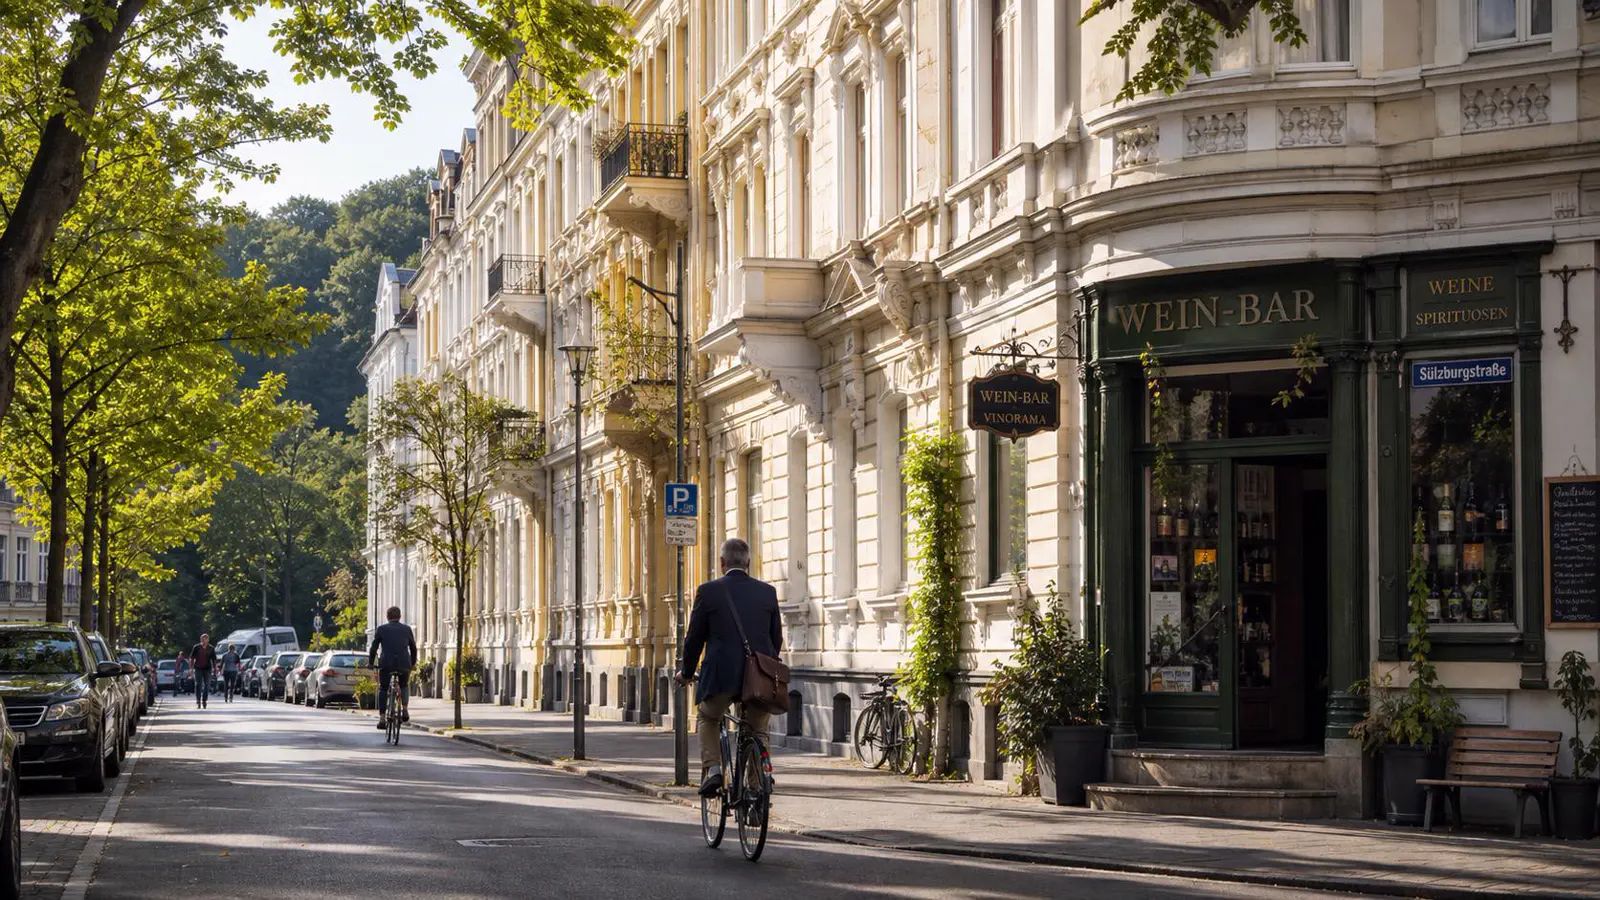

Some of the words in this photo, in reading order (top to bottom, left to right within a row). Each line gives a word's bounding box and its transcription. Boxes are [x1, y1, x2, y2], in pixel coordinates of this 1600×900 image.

[1428, 276, 1494, 295] WEINE
[1115, 289, 1319, 336] WEIN-BAR
[1416, 307, 1508, 326] SPIRITUOSEN
[1420, 363, 1506, 381] Sülzburgstraße
[980, 390, 1050, 404] WEIN-BAR
[983, 412, 1047, 424] VINORAMA
[673, 487, 689, 509] P
